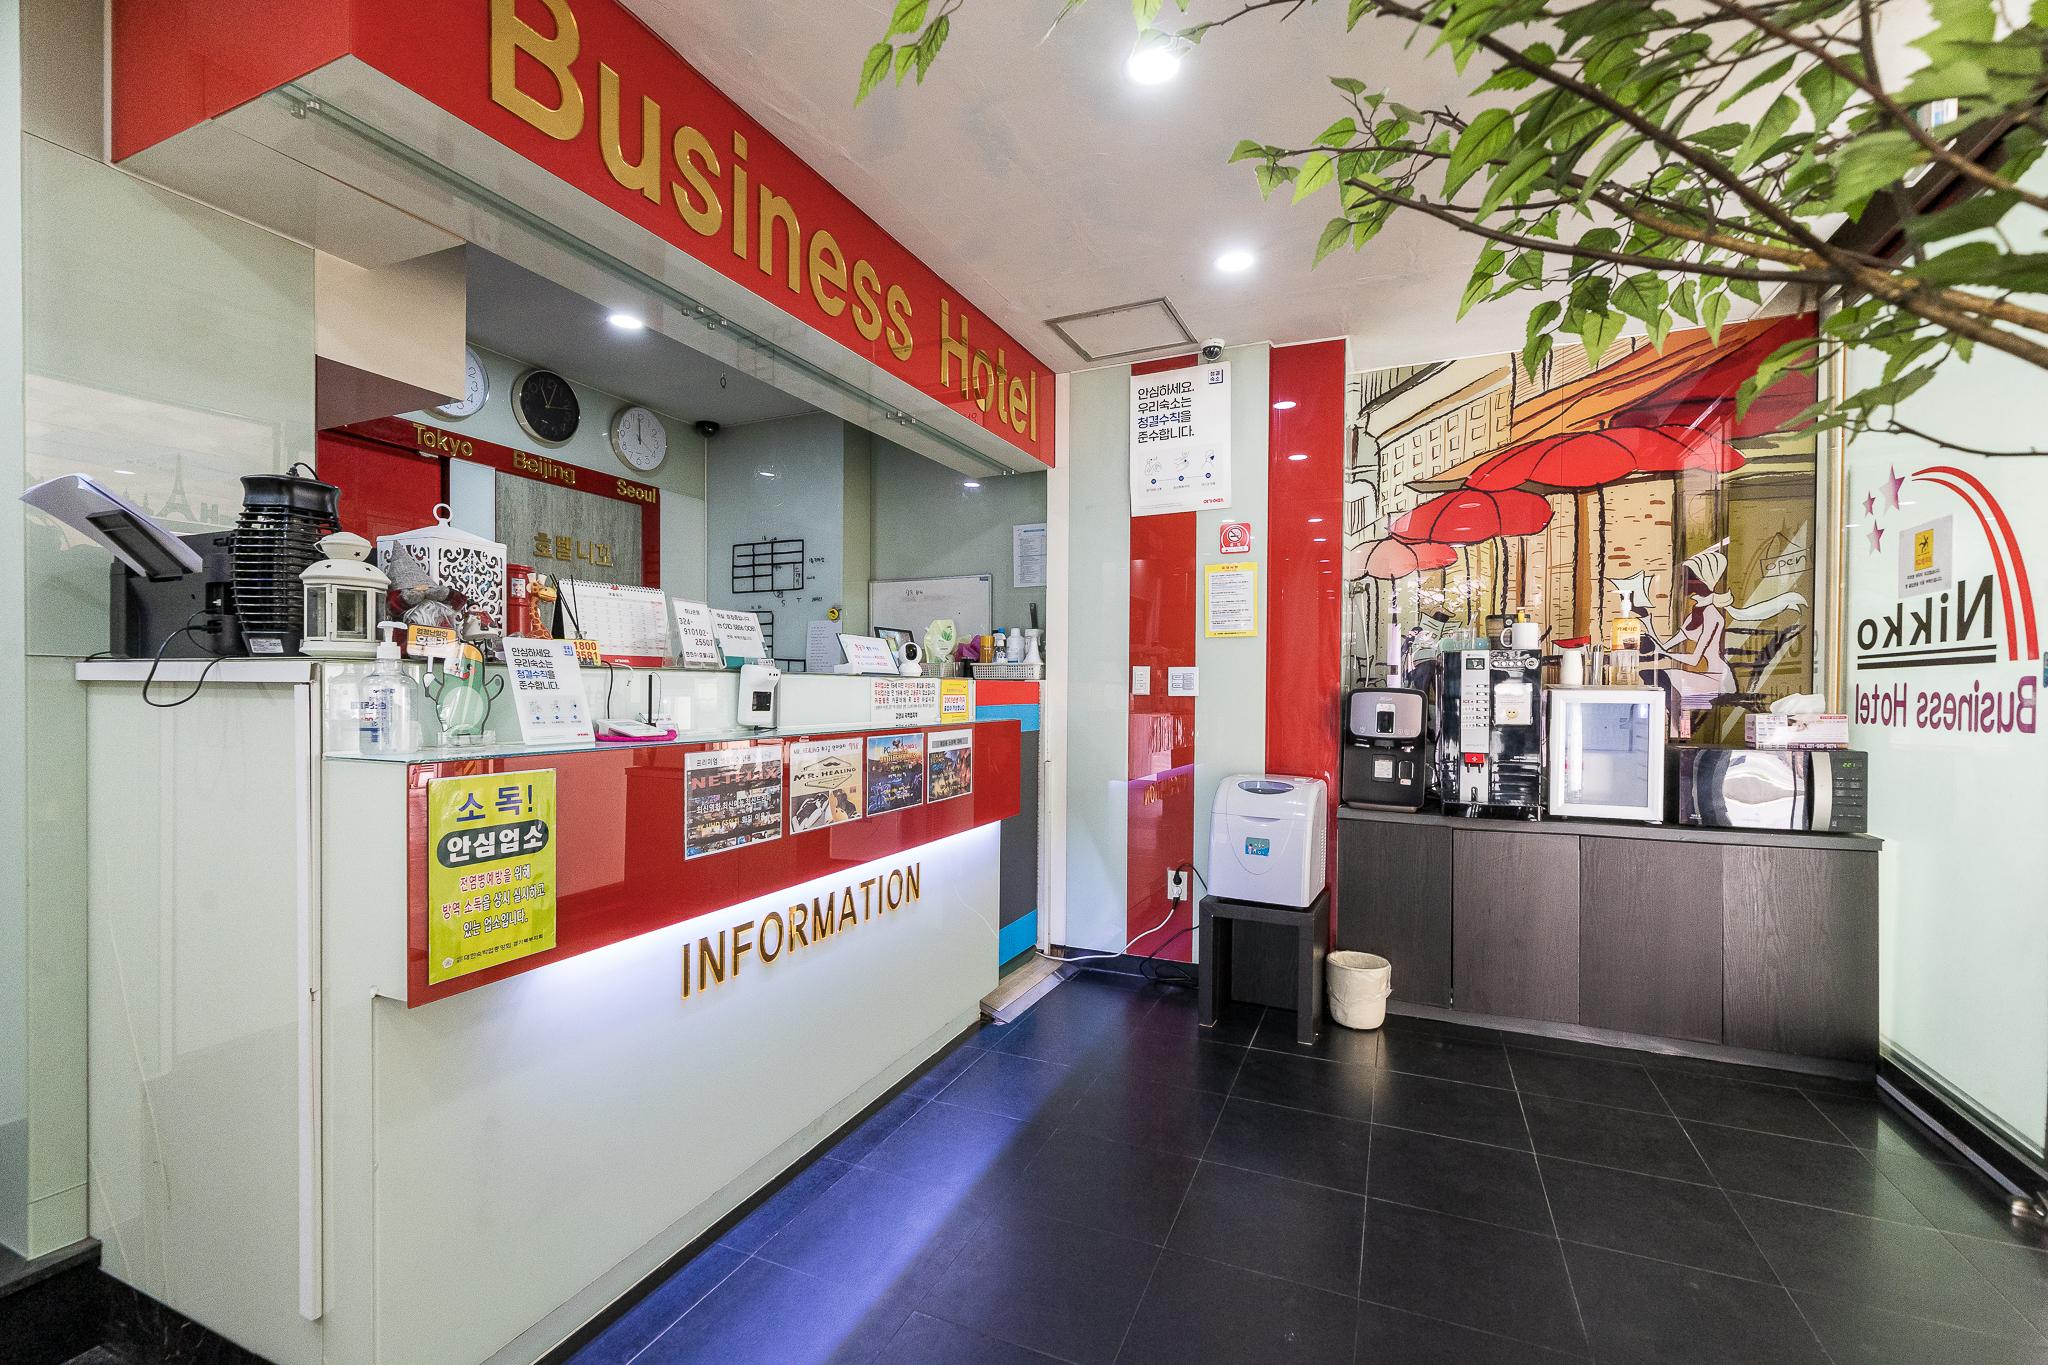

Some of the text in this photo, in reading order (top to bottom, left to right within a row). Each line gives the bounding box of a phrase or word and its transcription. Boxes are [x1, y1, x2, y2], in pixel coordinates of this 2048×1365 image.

[489, 0, 1037, 441] Business Hotel
[1137, 381, 1194, 400] 안심하세요.
[1137, 396, 1192, 415] 우리숙소는
[1137, 410, 1192, 429] 청결수칙을
[413, 423, 473, 457] Tokyo
[1137, 425, 1194, 444] 준수합니다.
[512, 449, 577, 484] Beijing
[616, 479, 657, 504] Seoul
[1765, 553, 1808, 572] open
[512, 647, 553, 658] 안심하세요.
[514, 658, 554, 668] 우리숙소는
[519, 680, 560, 690] 준수합니다.
[691, 767, 777, 790] NETFLIX
[794, 767, 856, 782] MR. HEALING
[446, 824, 544, 863] 안심업소
[460, 864, 531, 892] 전염병예방을 위해
[442, 882, 545, 919] 방역 소독을 상시 실시하고
[463, 908, 528, 939] 있는 업소입니다.
[681, 861, 921, 999] INFORMATION
